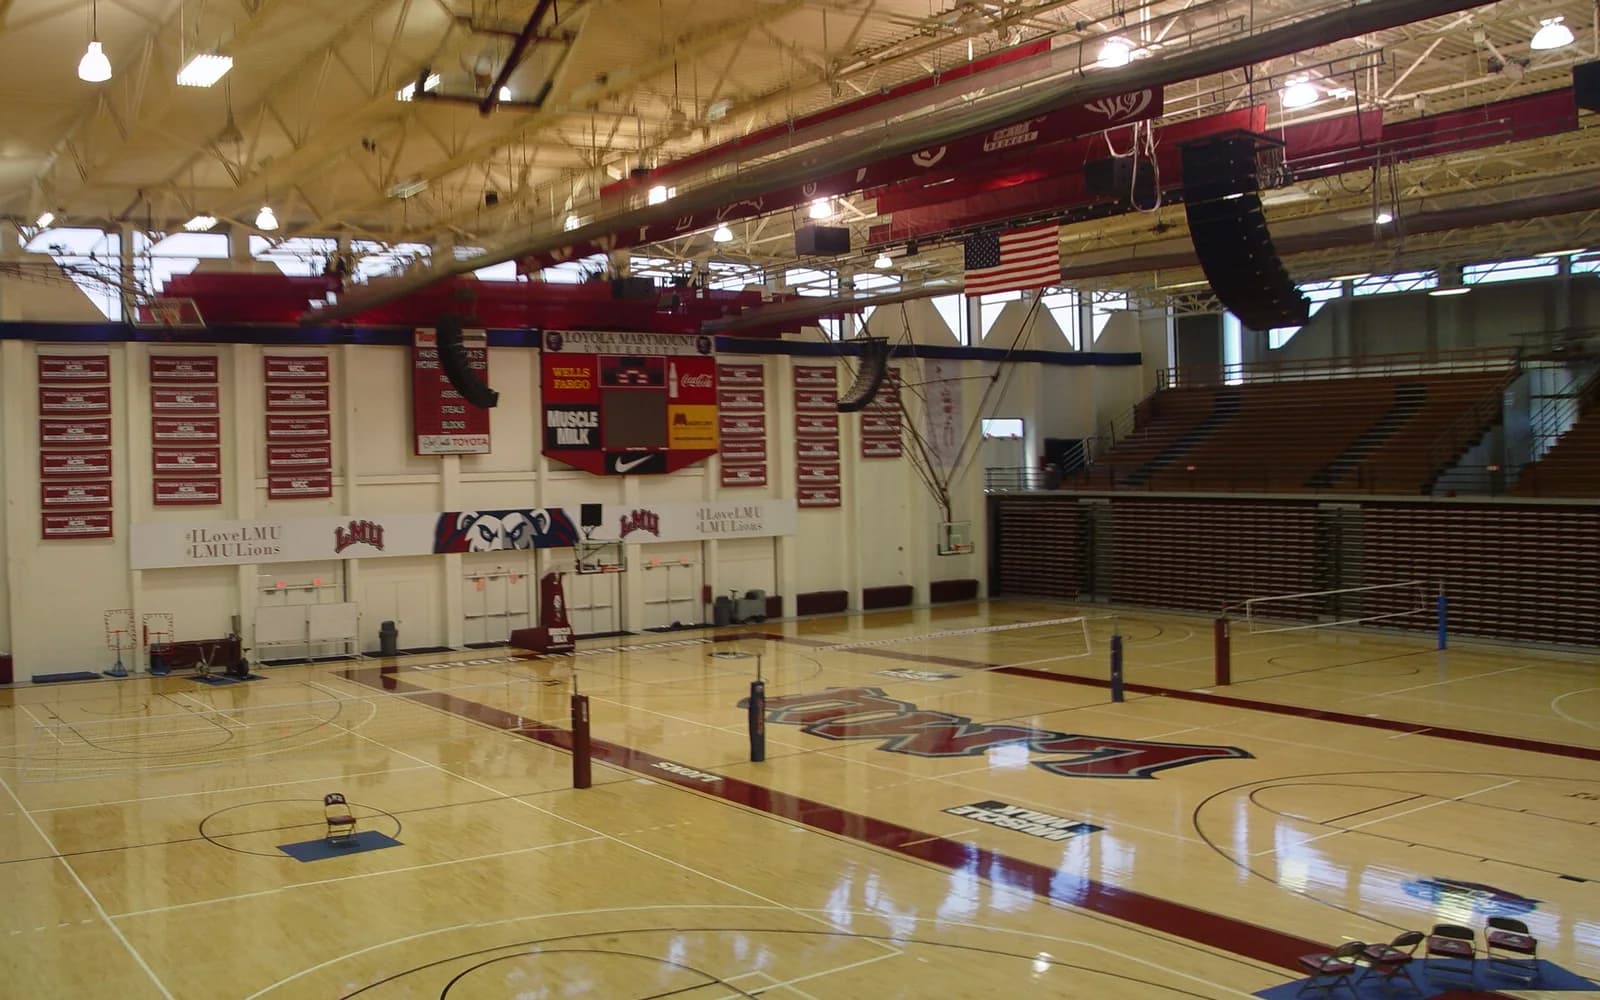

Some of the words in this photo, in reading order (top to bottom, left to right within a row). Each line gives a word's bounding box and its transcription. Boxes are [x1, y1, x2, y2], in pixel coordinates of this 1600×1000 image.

[564, 332, 616, 345] LOYOLA
[620, 333, 696, 347] MARYMOUNT
[584, 344, 680, 354] UNIVERSITY
[551, 367, 591, 377] WELLS
[552, 379, 592, 389] FARGO
[441, 405, 466, 414] STEALS
[441, 420, 466, 429] BLOCKS
[547, 410, 599, 428] MUSCLE
[451, 438, 488, 448] TOYOTA
[556, 427, 590, 445] MILK
[620, 507, 659, 538] LMU
[335, 520, 384, 553] LMU
[649, 761, 723, 783] LIONS
[944, 805, 1077, 841] MUSCLE
[990, 804, 1084, 830] MILK
